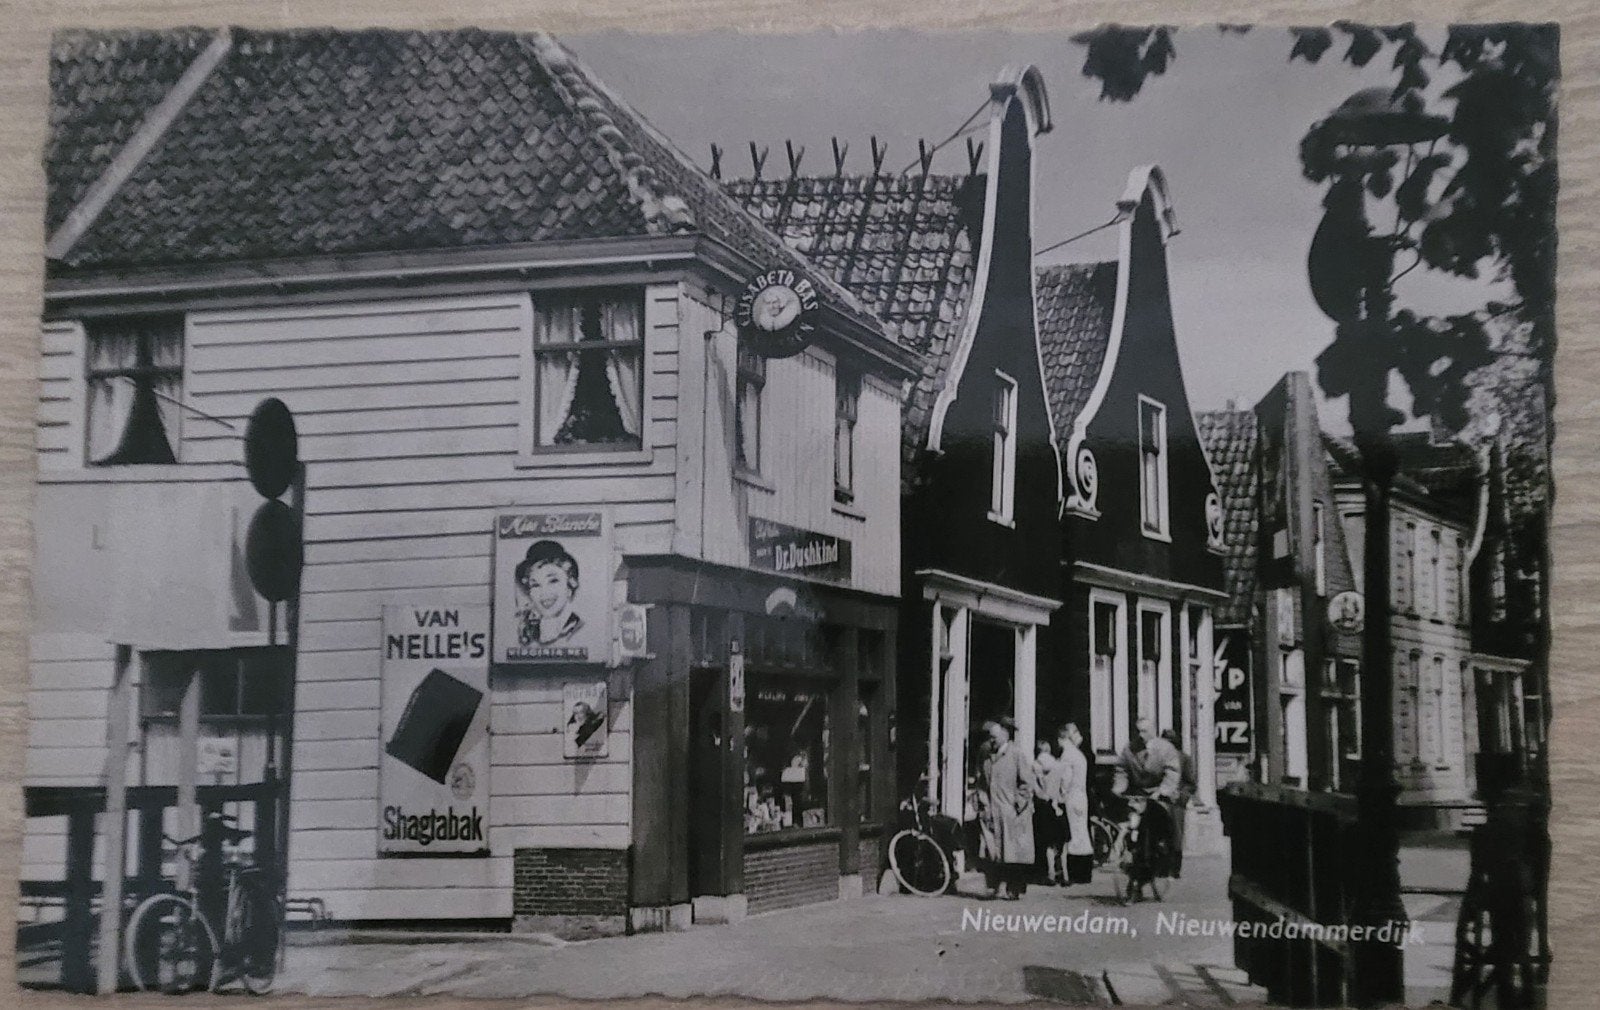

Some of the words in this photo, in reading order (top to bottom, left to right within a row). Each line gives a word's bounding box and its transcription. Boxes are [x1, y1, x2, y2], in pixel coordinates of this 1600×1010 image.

[794, 278, 819, 310] BAS
[414, 609, 459, 628] VAN
[386, 631, 485, 660] NELLE'S
[384, 805, 482, 846] Shagtabak
